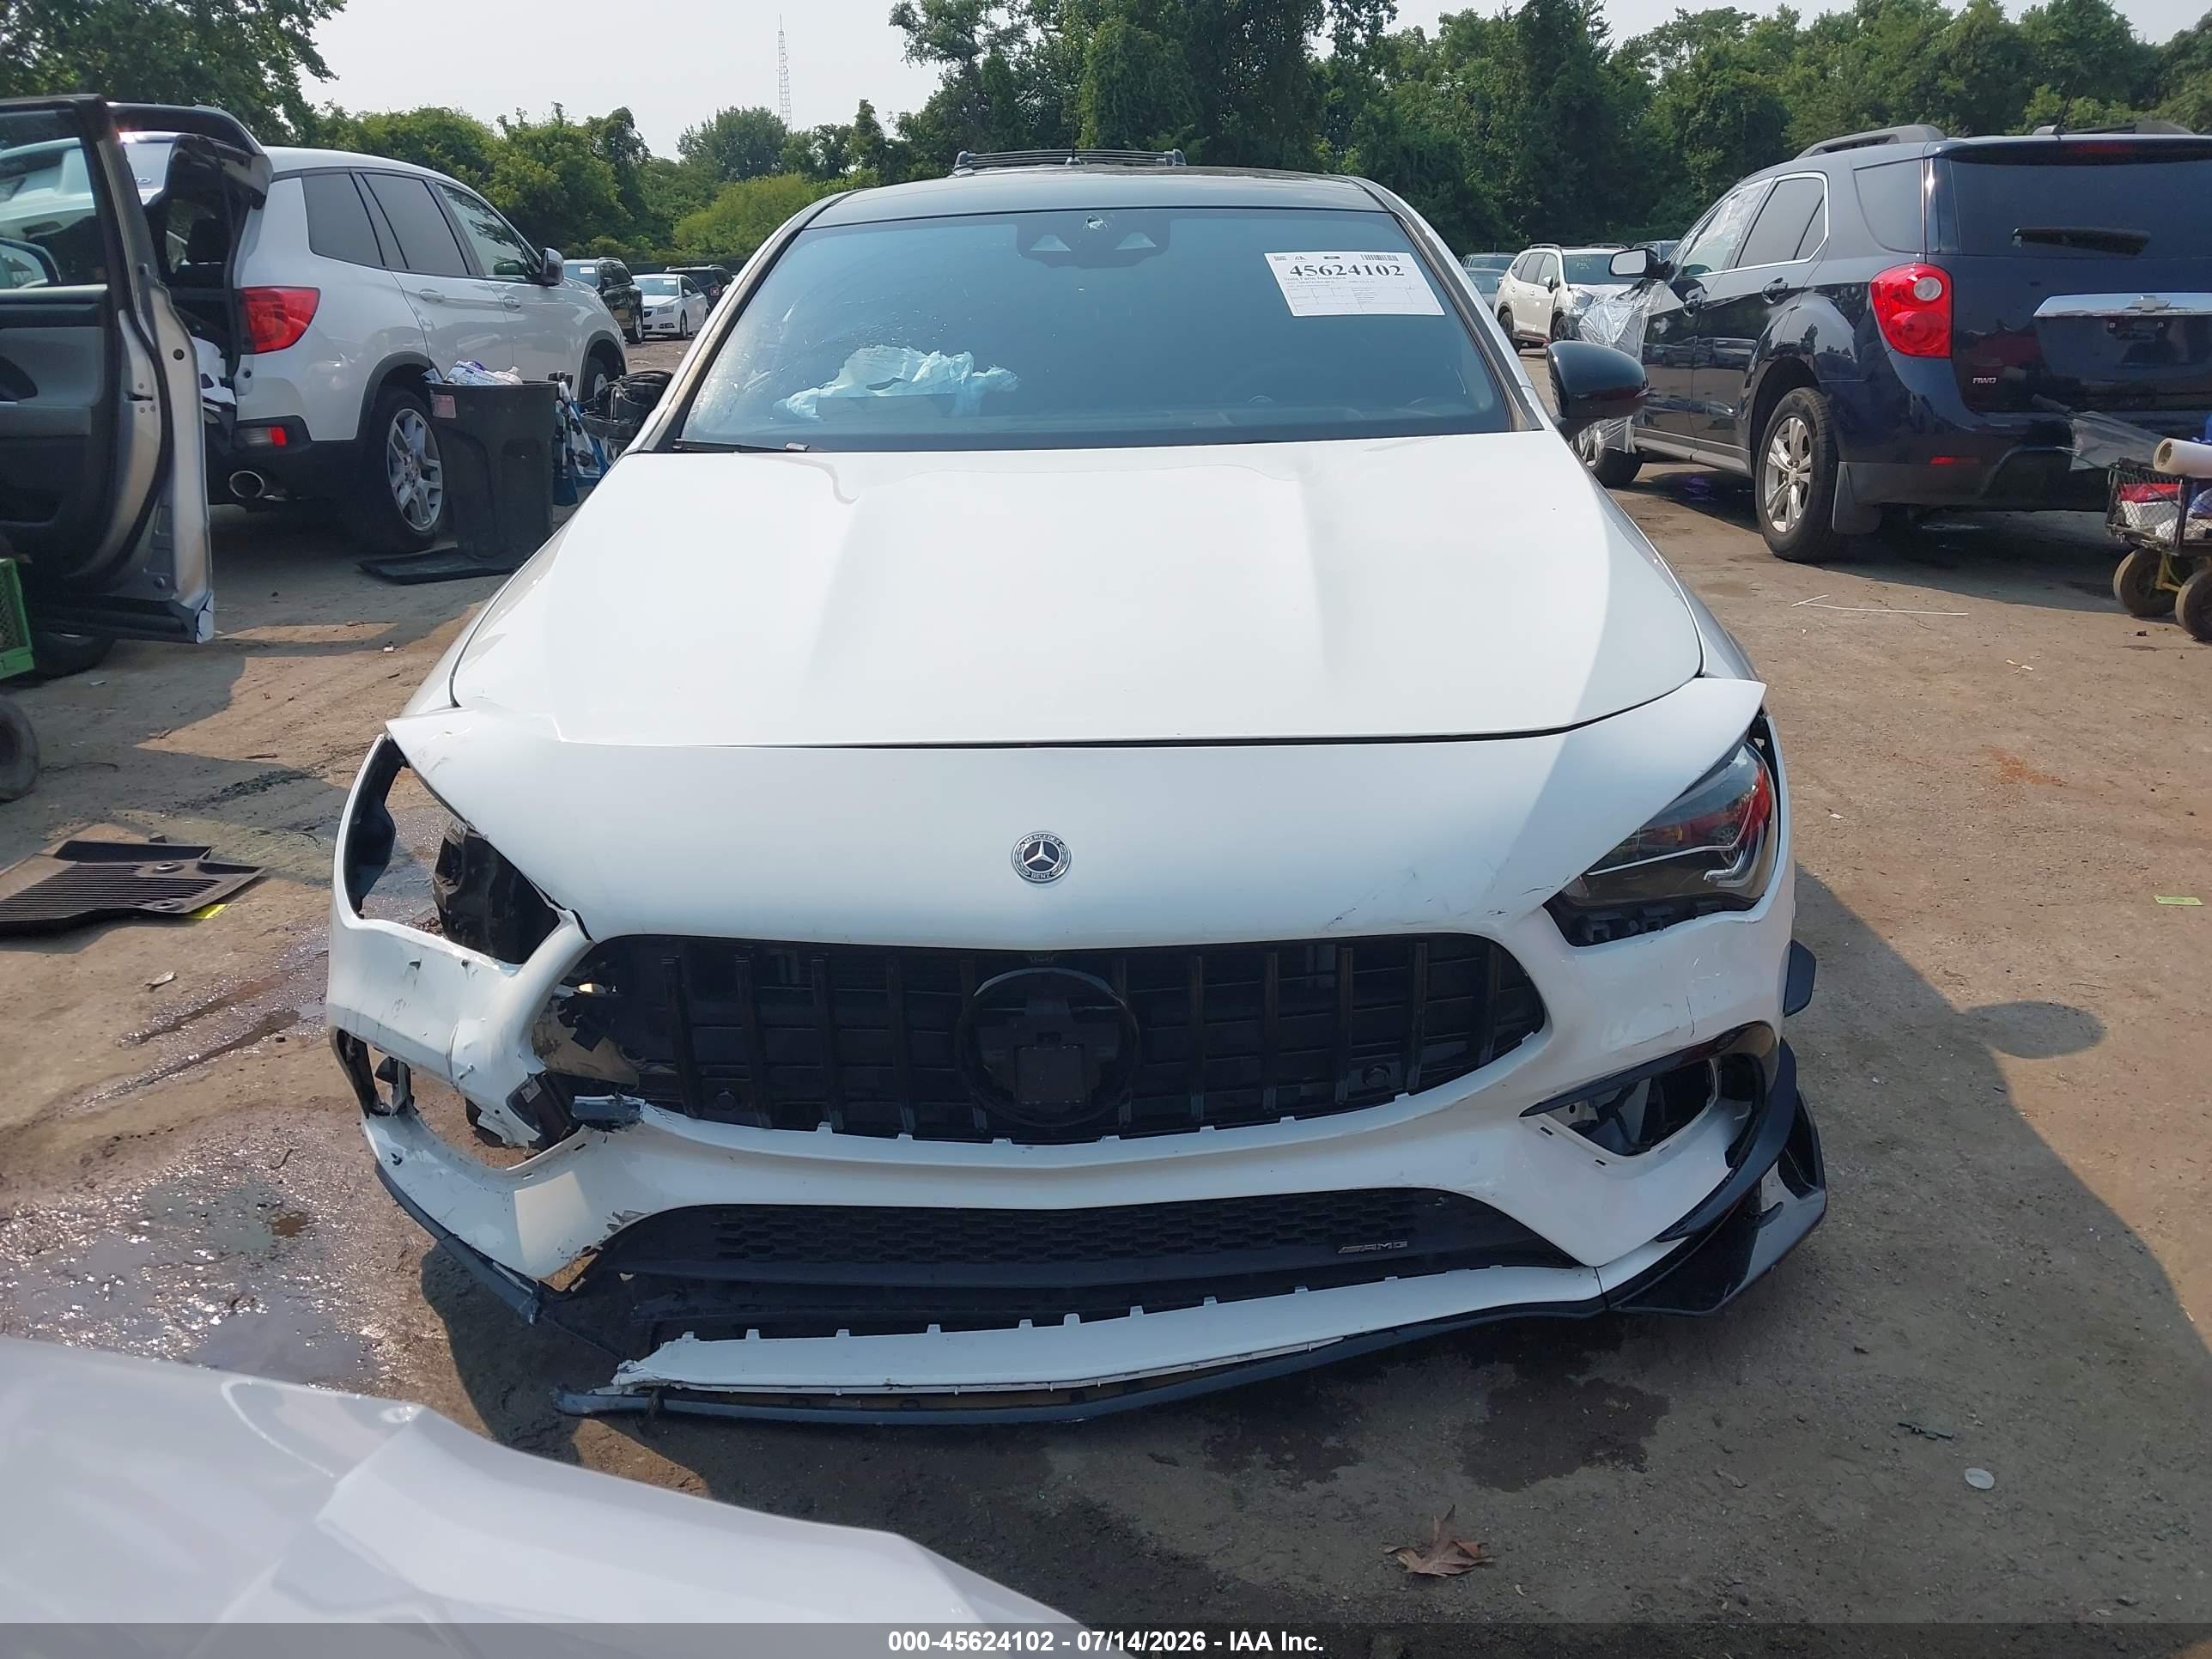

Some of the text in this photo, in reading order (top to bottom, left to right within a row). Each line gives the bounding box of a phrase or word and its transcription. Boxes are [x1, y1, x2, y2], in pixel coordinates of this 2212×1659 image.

[1290, 264, 1405, 276] 45624102
[1024, 834, 1061, 845] MERCEDES
[1359, 1240, 1408, 1253] AMG
